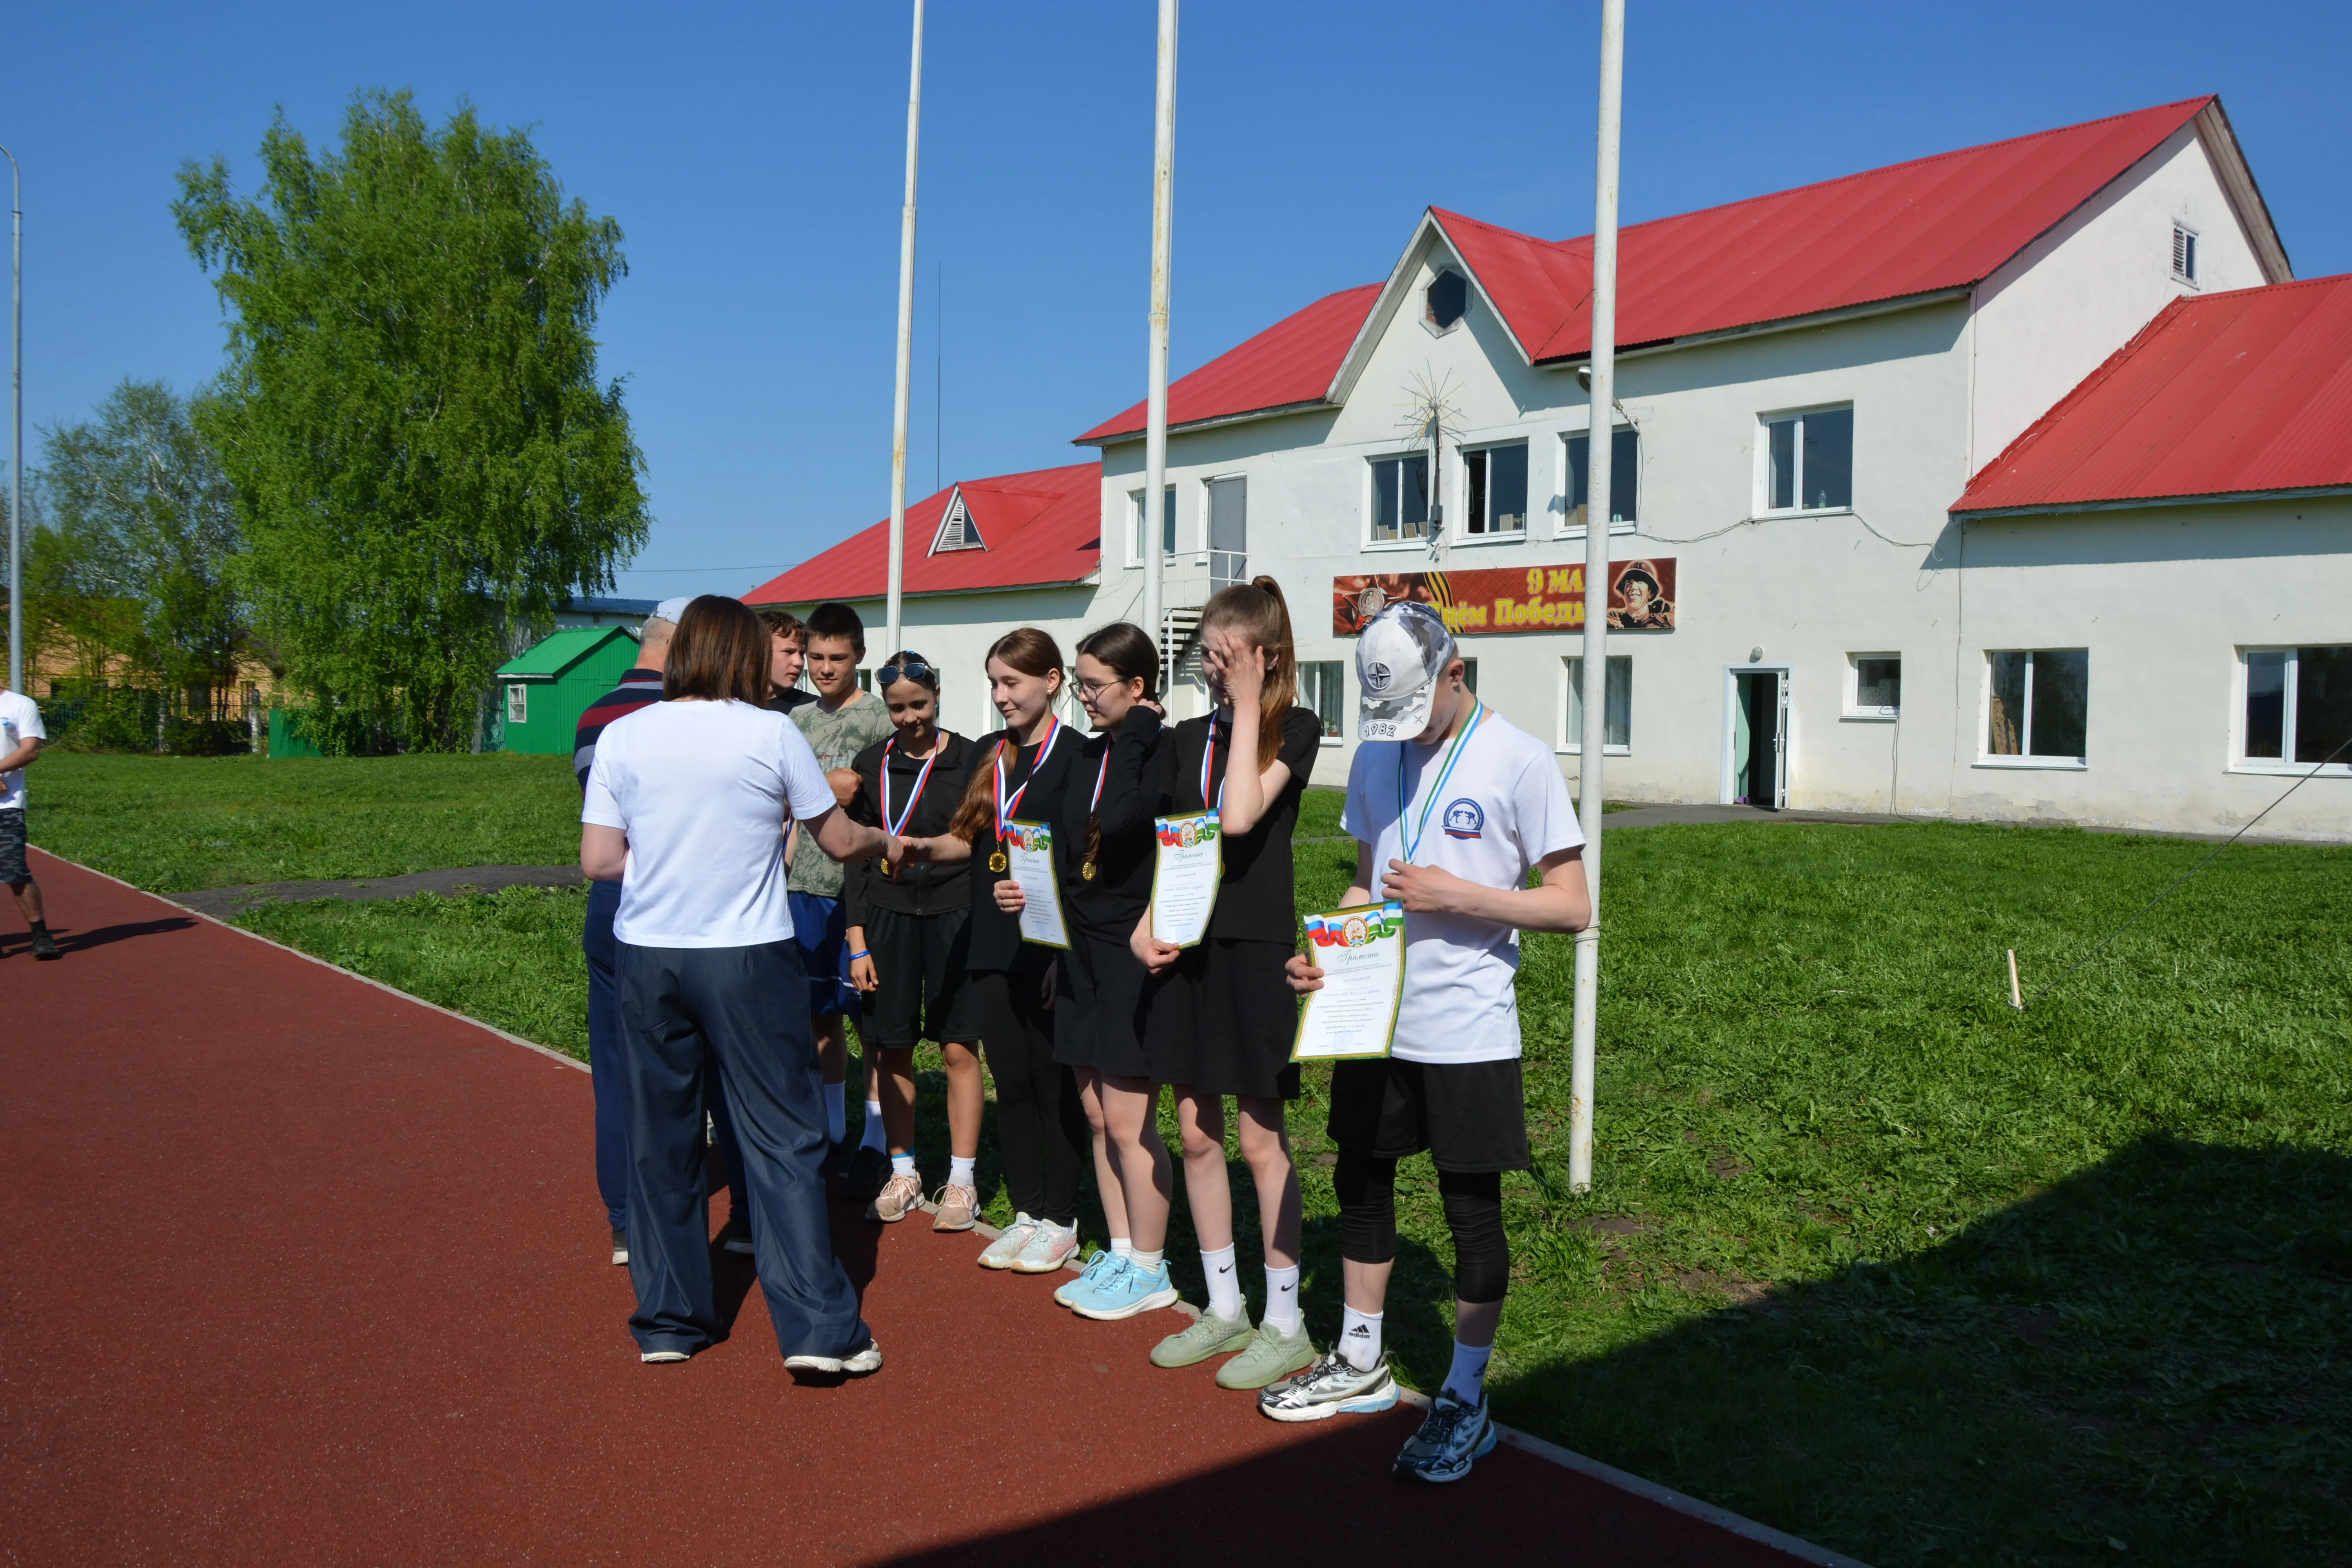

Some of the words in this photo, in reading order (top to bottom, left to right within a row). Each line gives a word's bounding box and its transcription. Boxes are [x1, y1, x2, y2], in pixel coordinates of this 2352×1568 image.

[1528, 568, 1544, 593] 9
[1548, 568, 1585, 593] МА
[1365, 723, 1396, 737] 1982
[1174, 849, 1203, 862] Грамота
[1337, 950, 1379, 965] Грамота
